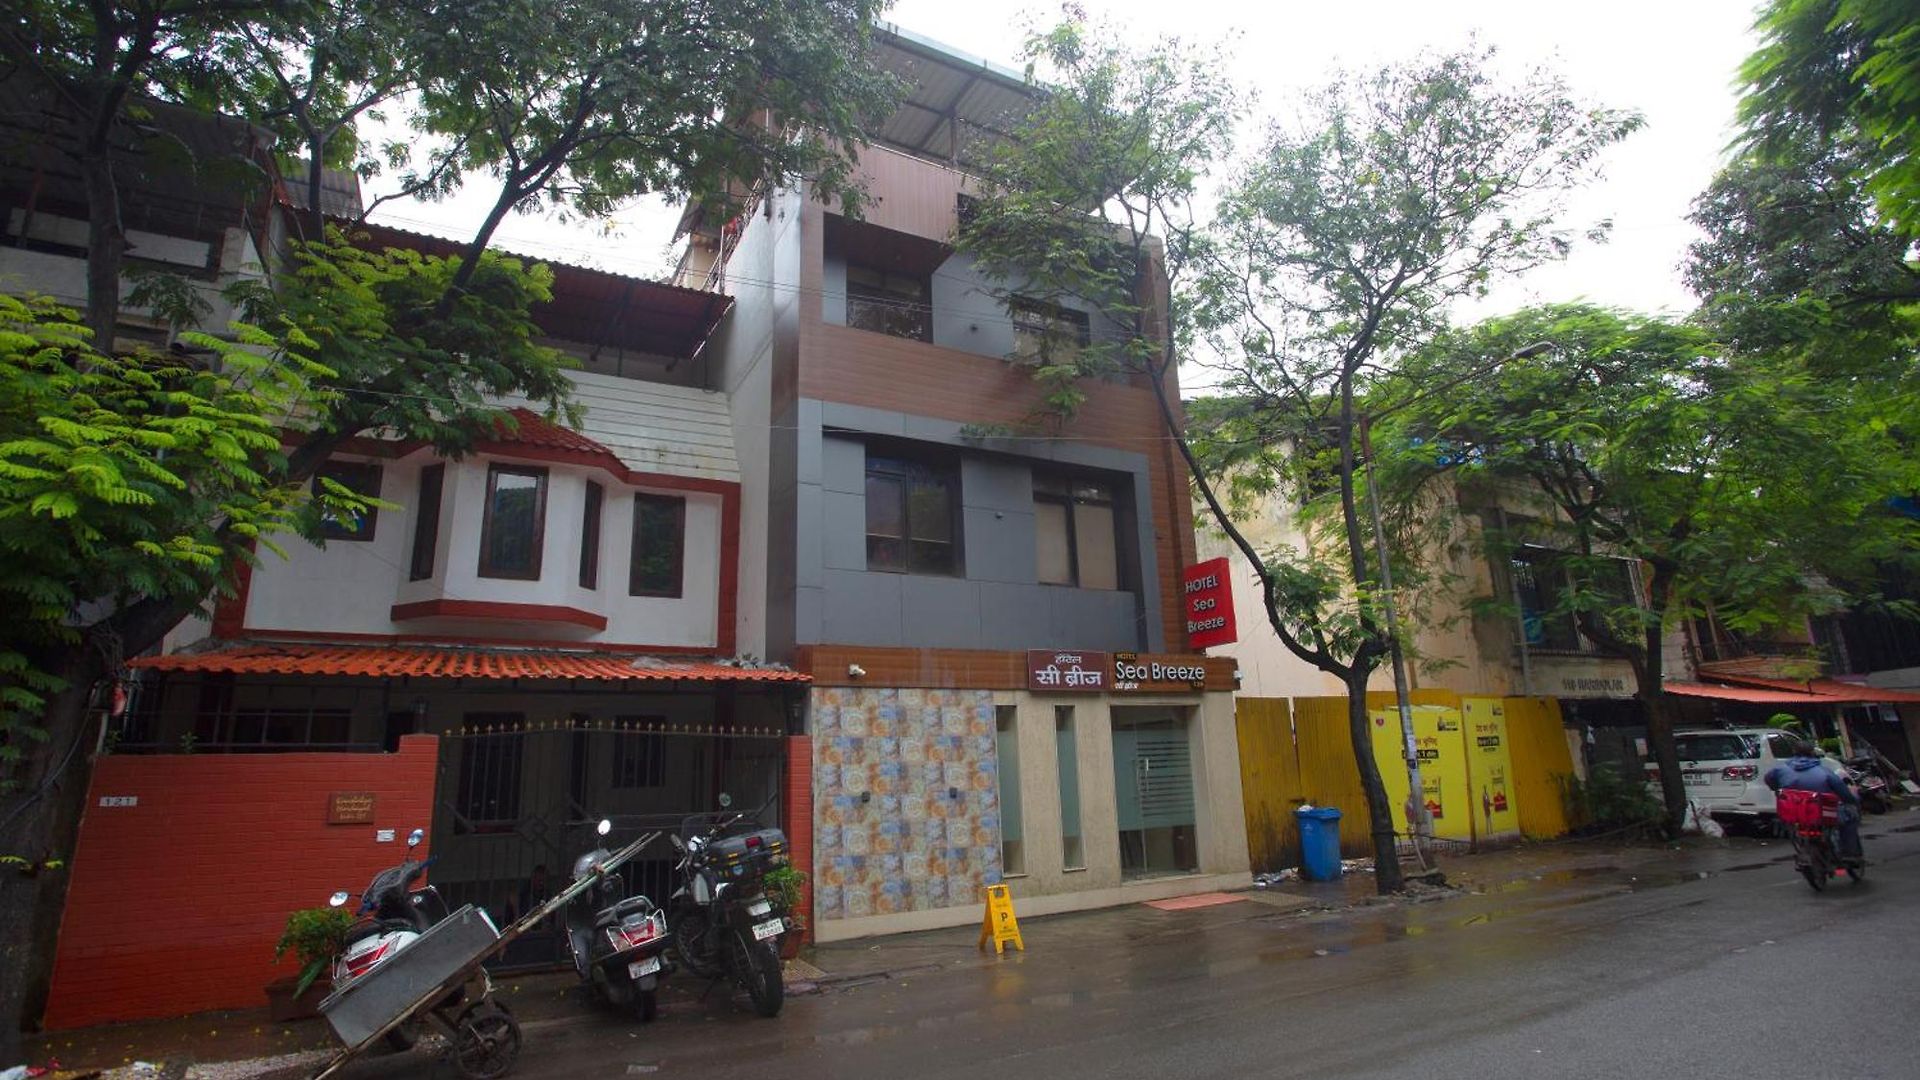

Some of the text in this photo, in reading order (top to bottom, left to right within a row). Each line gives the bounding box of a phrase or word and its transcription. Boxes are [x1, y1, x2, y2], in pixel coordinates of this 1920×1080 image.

[1185, 575, 1218, 593] HOTEL
[1193, 598, 1215, 612] Sea
[1187, 616, 1225, 633] Breeze
[1035, 664, 1102, 687] सी ब्रीज
[1116, 661, 1205, 680] Sea Breeze
